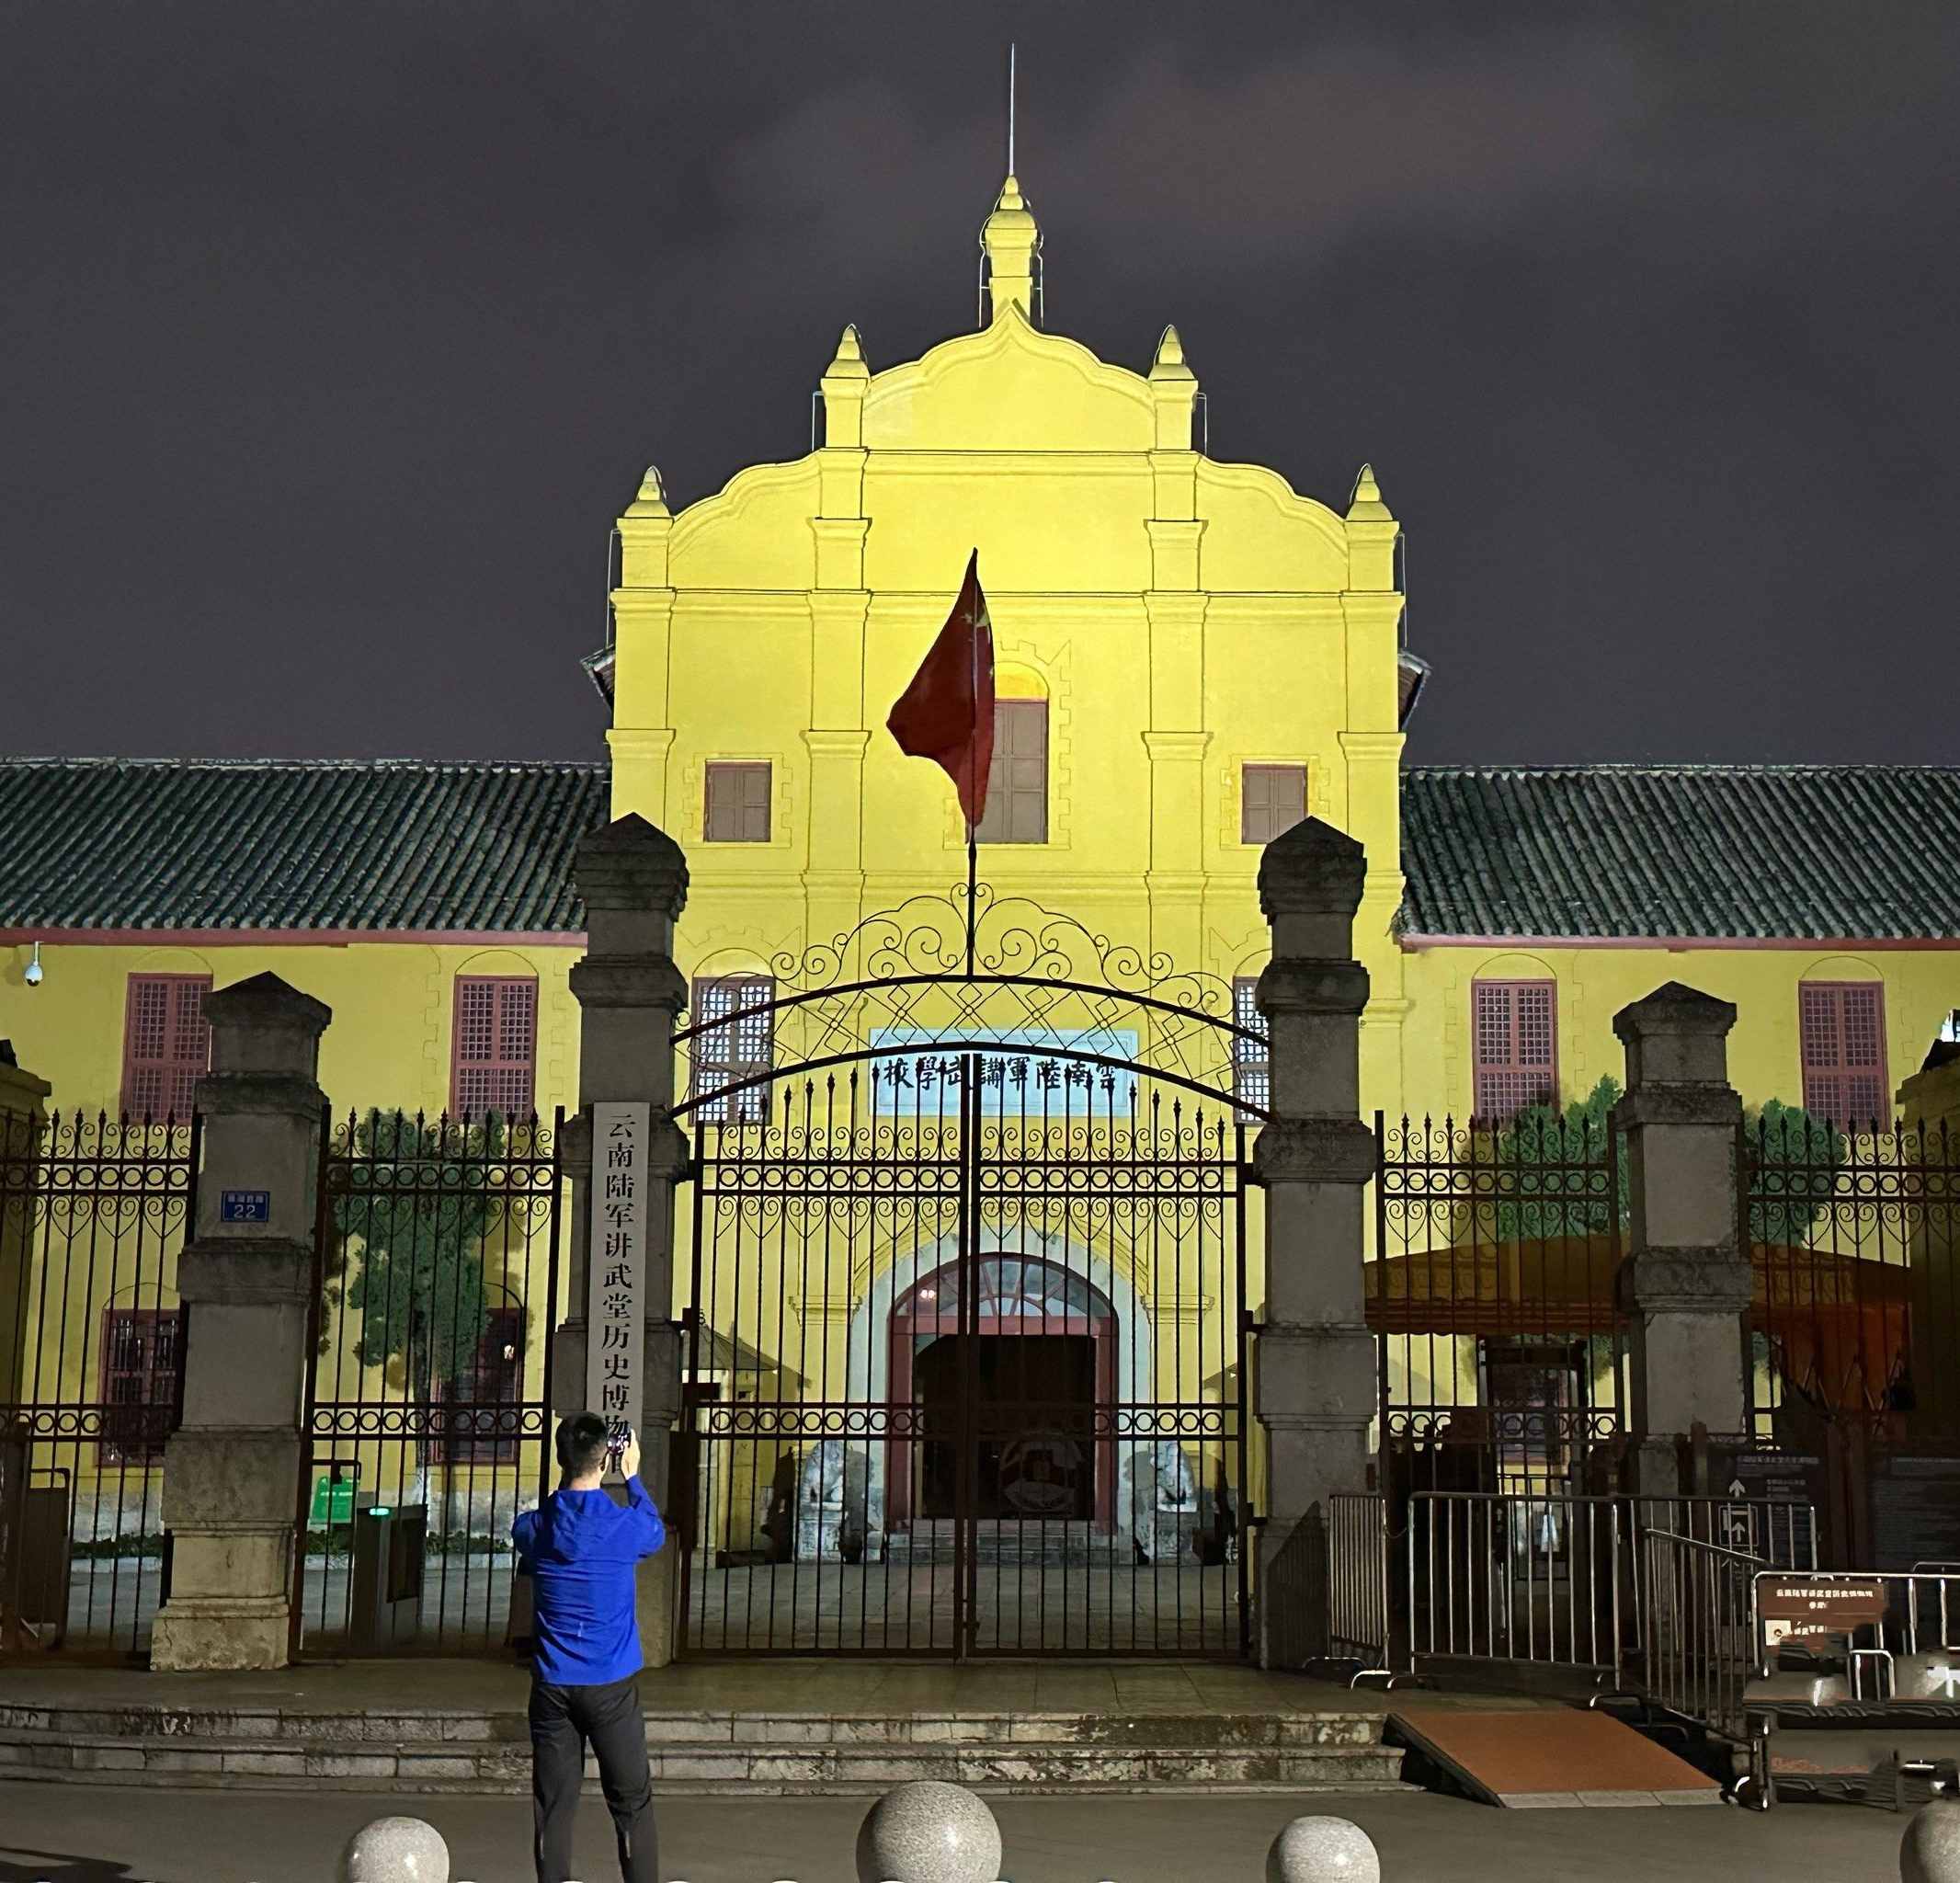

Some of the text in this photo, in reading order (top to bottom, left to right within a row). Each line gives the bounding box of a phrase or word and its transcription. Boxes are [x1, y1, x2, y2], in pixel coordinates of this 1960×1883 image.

[234, 1204, 256, 1218] 22
[601, 1113, 635, 1474] 云南陆军讲武堂历史博物
